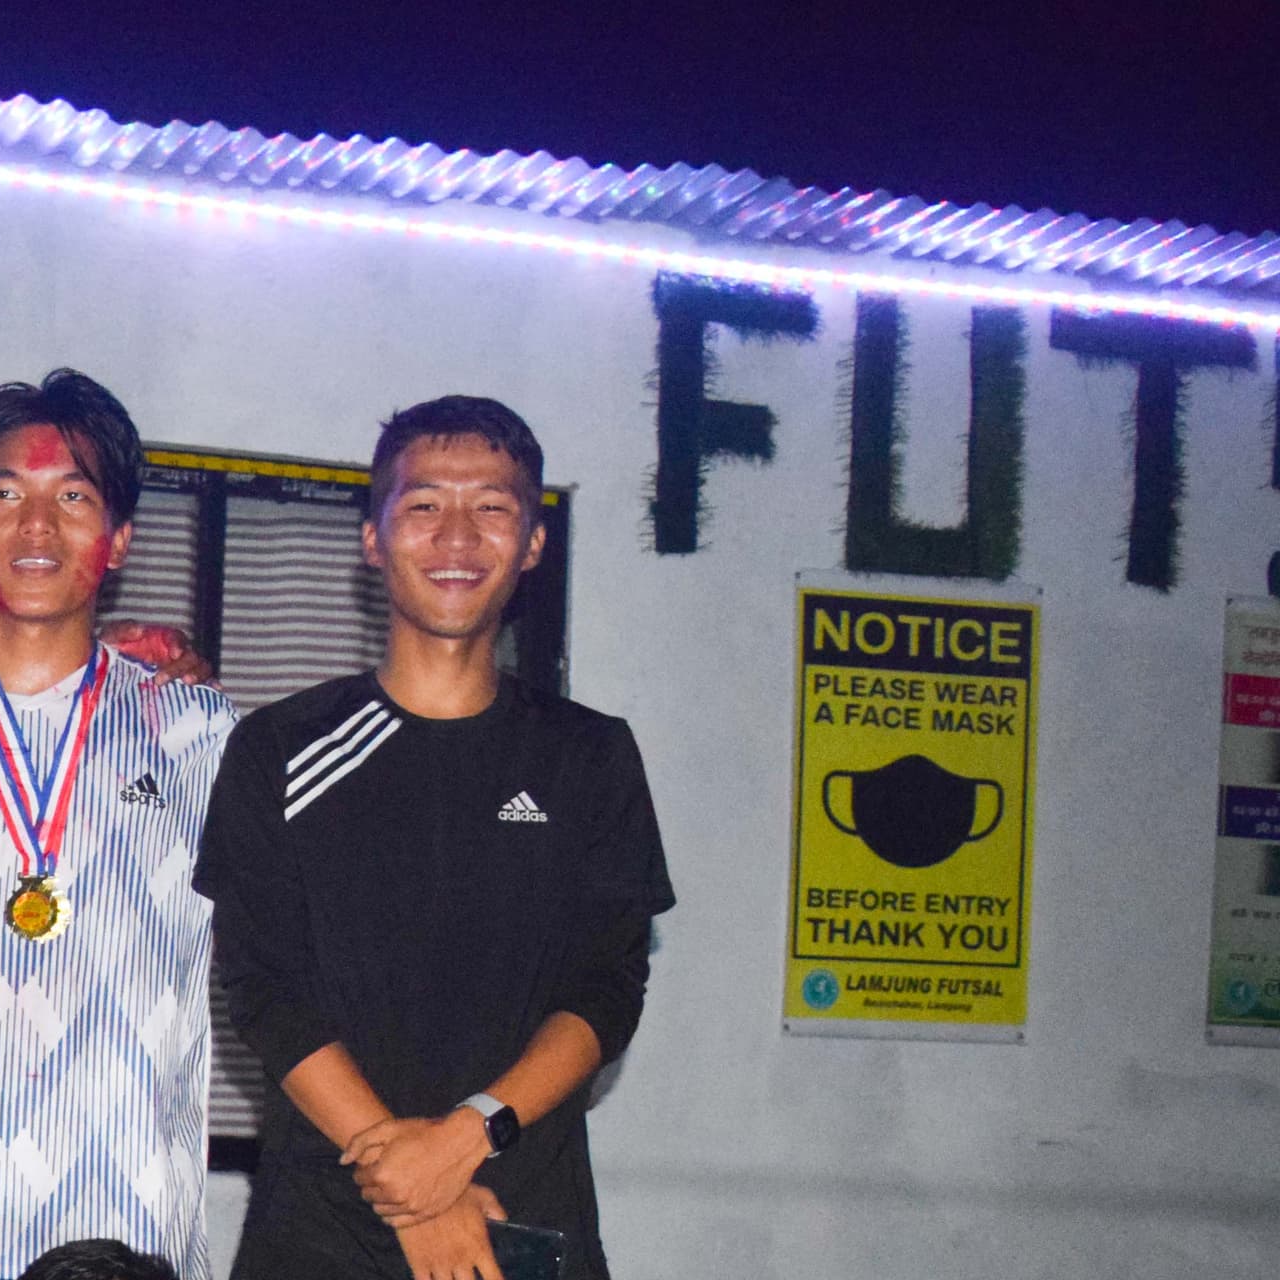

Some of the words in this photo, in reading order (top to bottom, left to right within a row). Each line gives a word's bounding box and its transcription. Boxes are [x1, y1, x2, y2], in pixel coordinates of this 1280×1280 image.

[650, 270, 1280, 597] FUT
[813, 608, 1023, 664] NOTICE
[814, 673, 925, 701] PLEASE
[935, 681, 1018, 708] WEAR
[814, 702, 834, 725] A
[844, 704, 921, 730] FACE
[932, 709, 1015, 736] MASK
[498, 809, 548, 822] adidas
[806, 888, 916, 912] BEFORE
[925, 893, 1011, 916] ENTRY
[806, 917, 926, 948] THANK
[937, 922, 1008, 952] YOU
[846, 975, 932, 994] LAMJUNG
[937, 978, 1004, 997] FUTSAL
